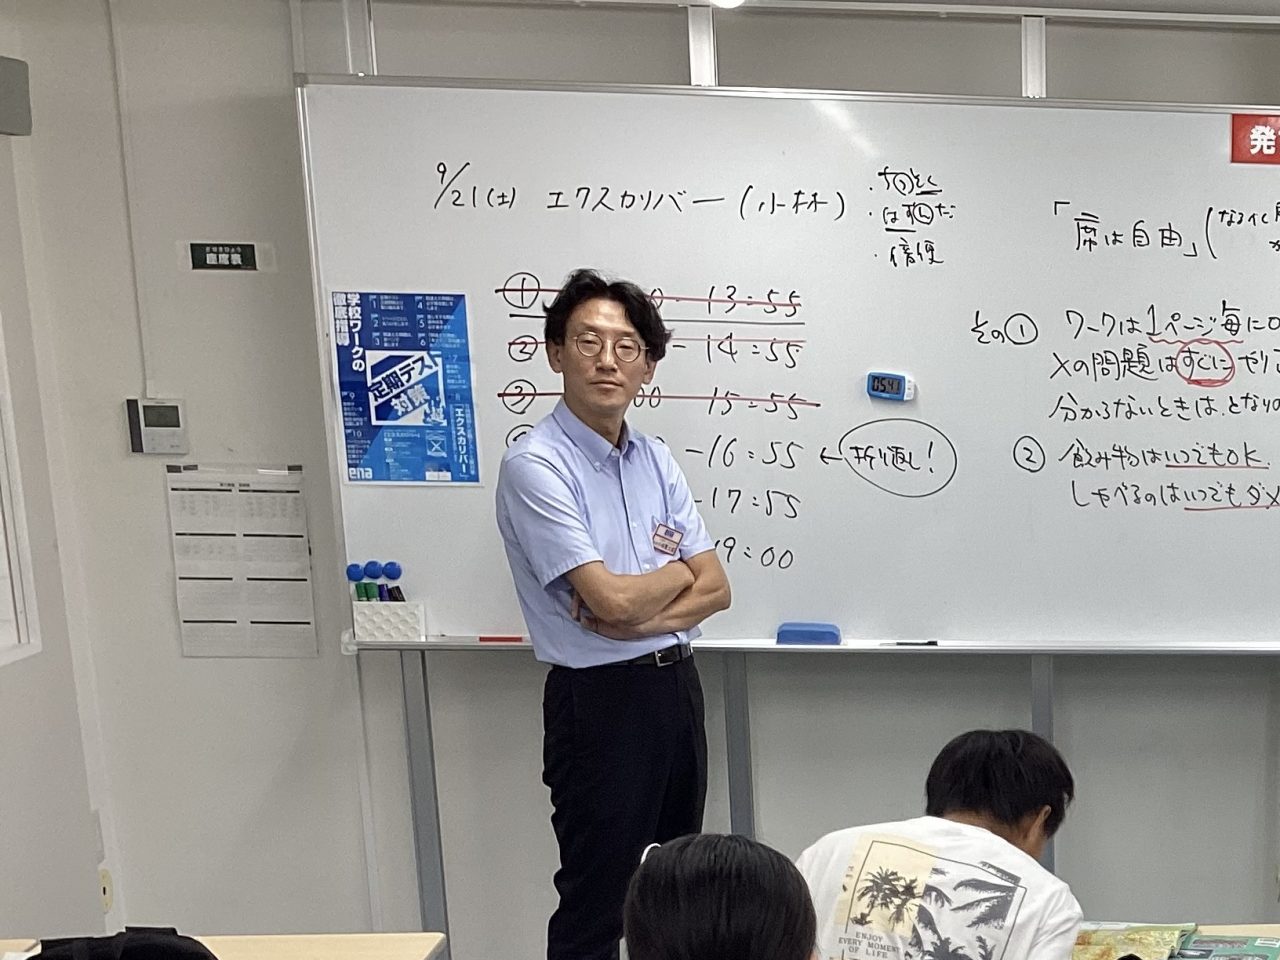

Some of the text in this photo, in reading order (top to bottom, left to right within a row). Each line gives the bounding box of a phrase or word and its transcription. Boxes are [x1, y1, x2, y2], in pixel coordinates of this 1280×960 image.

[547, 184, 726, 212] エクスカリバー
[346, 292, 366, 372] 学校ワークの
[368, 350, 443, 402] 定期テスト
[348, 467, 373, 479] ena
[839, 937, 862, 946] EVERY
[856, 932, 884, 942] ENJOY
[866, 949, 888, 959] LIFE
